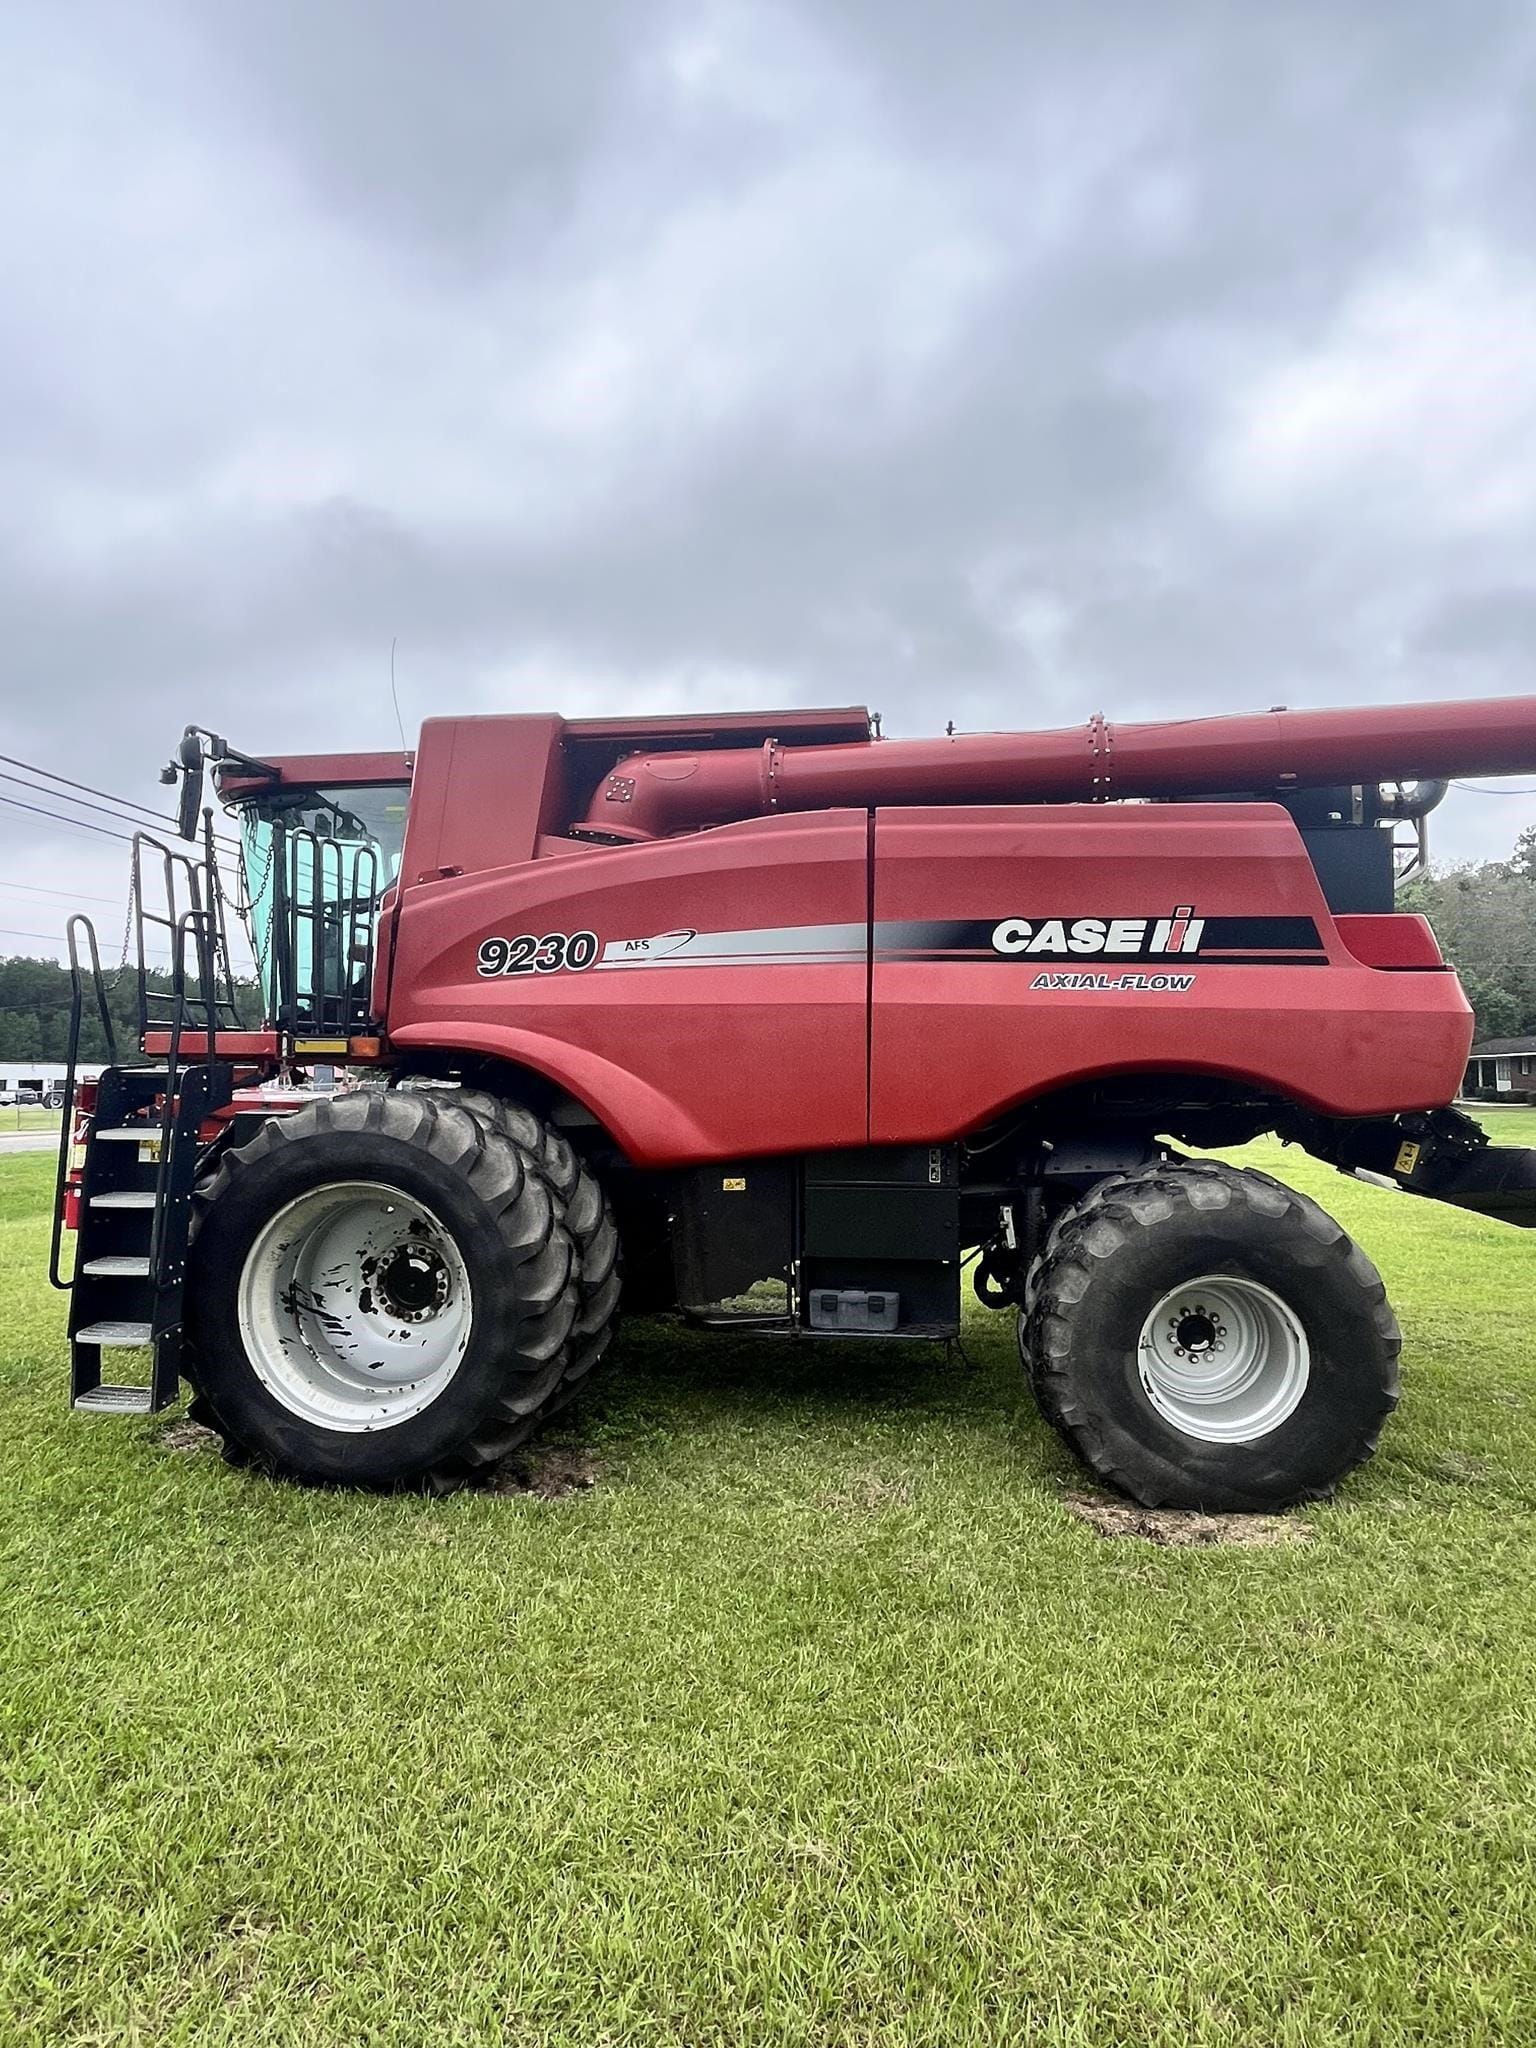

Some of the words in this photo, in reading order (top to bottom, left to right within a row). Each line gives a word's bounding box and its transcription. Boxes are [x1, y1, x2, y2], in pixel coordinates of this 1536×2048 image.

[624, 939, 650, 952] AFS
[992, 919, 1147, 953] CASE
[477, 931, 598, 977] 9230
[1030, 973, 1195, 991] AXIAL-FLOW
